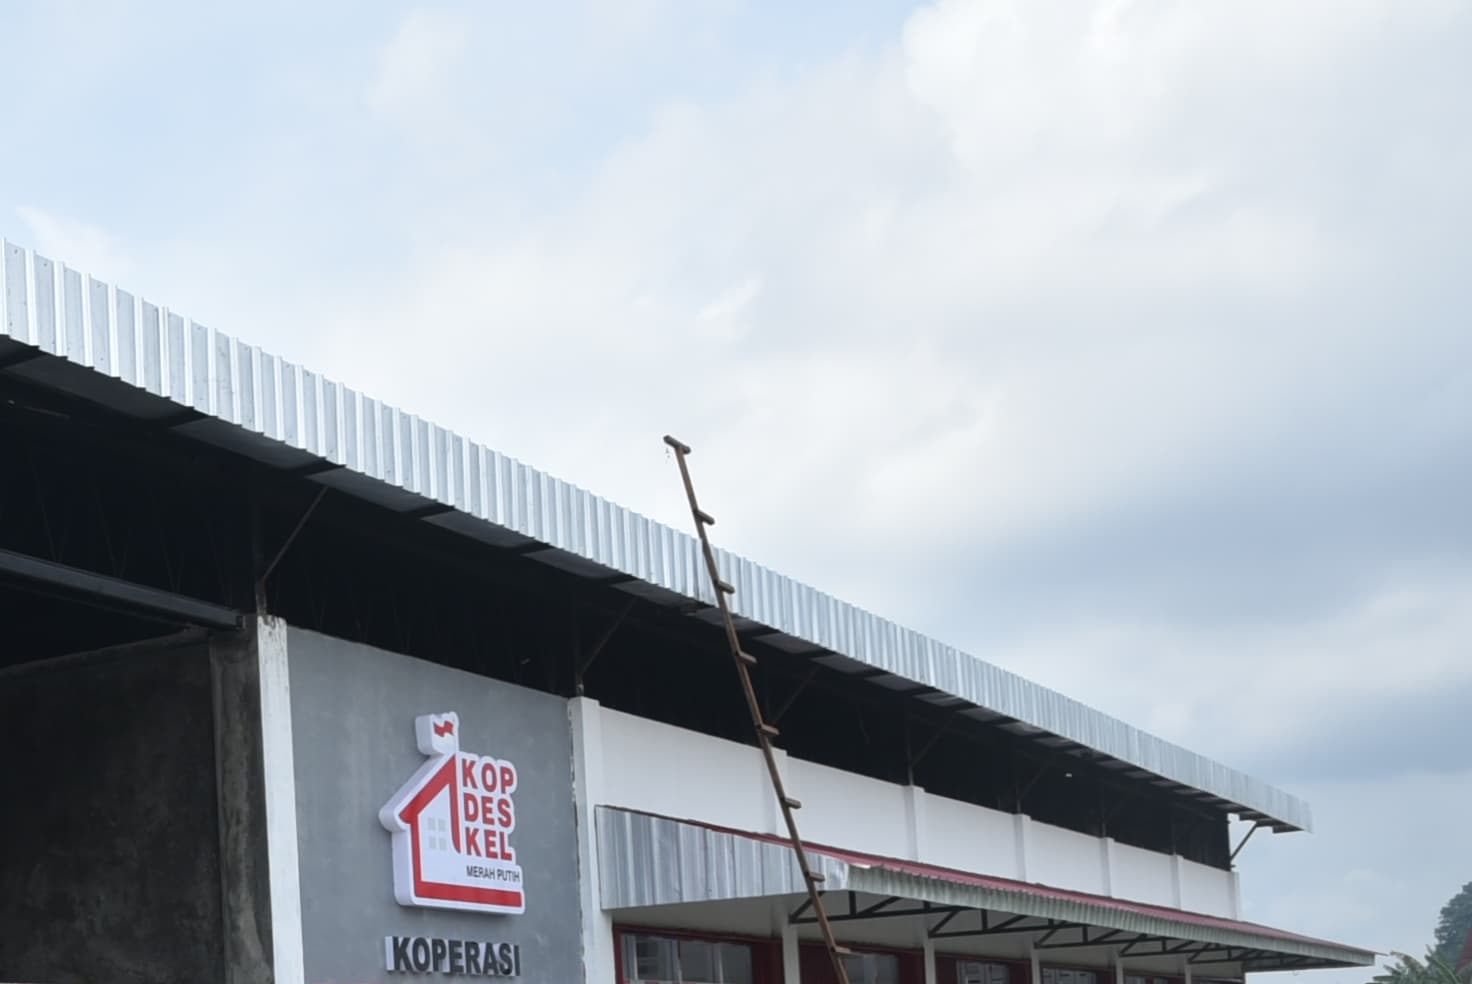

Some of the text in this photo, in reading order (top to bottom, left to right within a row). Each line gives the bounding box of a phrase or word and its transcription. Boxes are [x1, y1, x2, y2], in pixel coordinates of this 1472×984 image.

[461, 757, 515, 794] KOP
[463, 792, 512, 828] DES
[465, 826, 513, 861] KEL
[466, 865, 521, 882] MERAH PUTIH
[390, 935, 521, 976] KOPERASI
